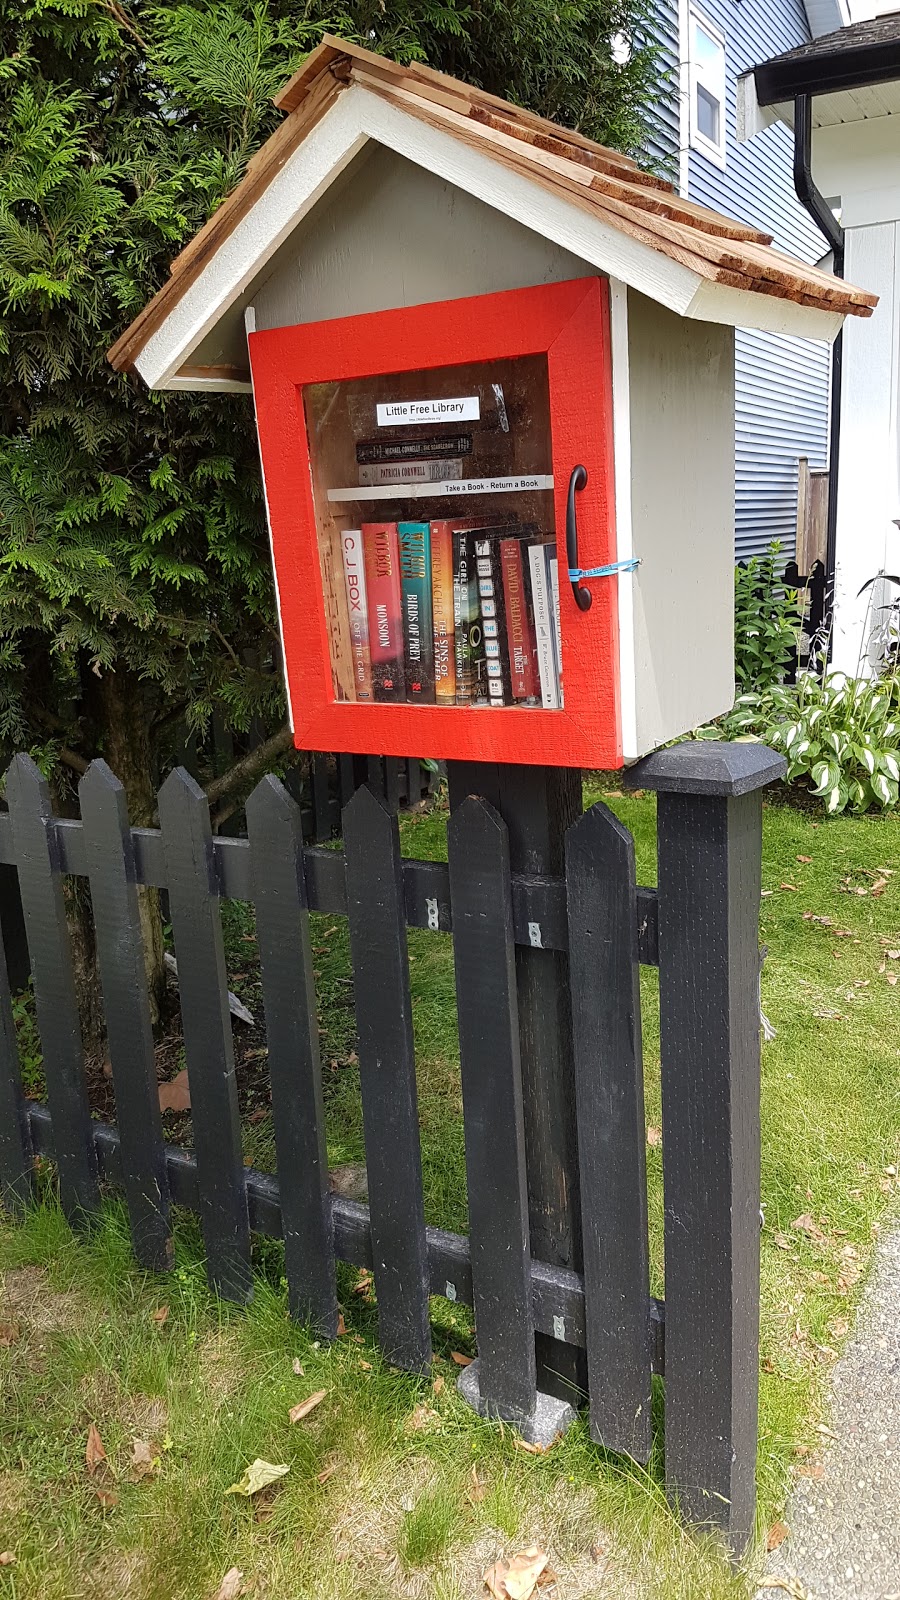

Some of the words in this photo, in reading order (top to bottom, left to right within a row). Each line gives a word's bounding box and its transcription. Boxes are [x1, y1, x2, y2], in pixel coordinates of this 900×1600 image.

[386, 407, 408, 416] Little
[410, 405, 430, 414] Free
[432, 403, 465, 414] Library
[380, 467, 401, 478] PATRICIA
[401, 466, 426, 477] CORNWELL
[445, 484, 461, 493] Take
[467, 482, 485, 491] Book
[490, 480, 513, 489] Return
[520, 479, 539, 488] Book
[343, 537, 355, 554] C.
[375, 530, 392, 577] WILBUR
[401, 532, 413, 580] SMITH
[411, 531, 425, 579] WILBUR
[432, 536, 443, 577] JEFFREY
[459, 537, 467, 556] THE
[345, 557, 357, 571] J.
[460, 560, 468, 585] GIRL
[534, 562, 542, 585] DOG'S
[453, 572, 461, 592] THE
[507, 563, 519, 593] DAVID
[348, 574, 361, 612] BOX
[433, 577, 443, 615] ARCHER
[407, 594, 418, 621] BIRDS
[454, 596, 462, 627] TRAIN
[353, 622, 362, 639] OFF
[377, 604, 391, 648] MONSOON
[408, 623, 419, 637] OF
[438, 619, 447, 636] THE
[509, 597, 523, 643] BALDACCI
[355, 642, 364, 658] THE
[409, 638, 421, 662] PREY
[439, 640, 449, 662] SINS
[514, 646, 525, 675] TARGET
[357, 660, 365, 682] GRID
[441, 664, 449, 677] OF
